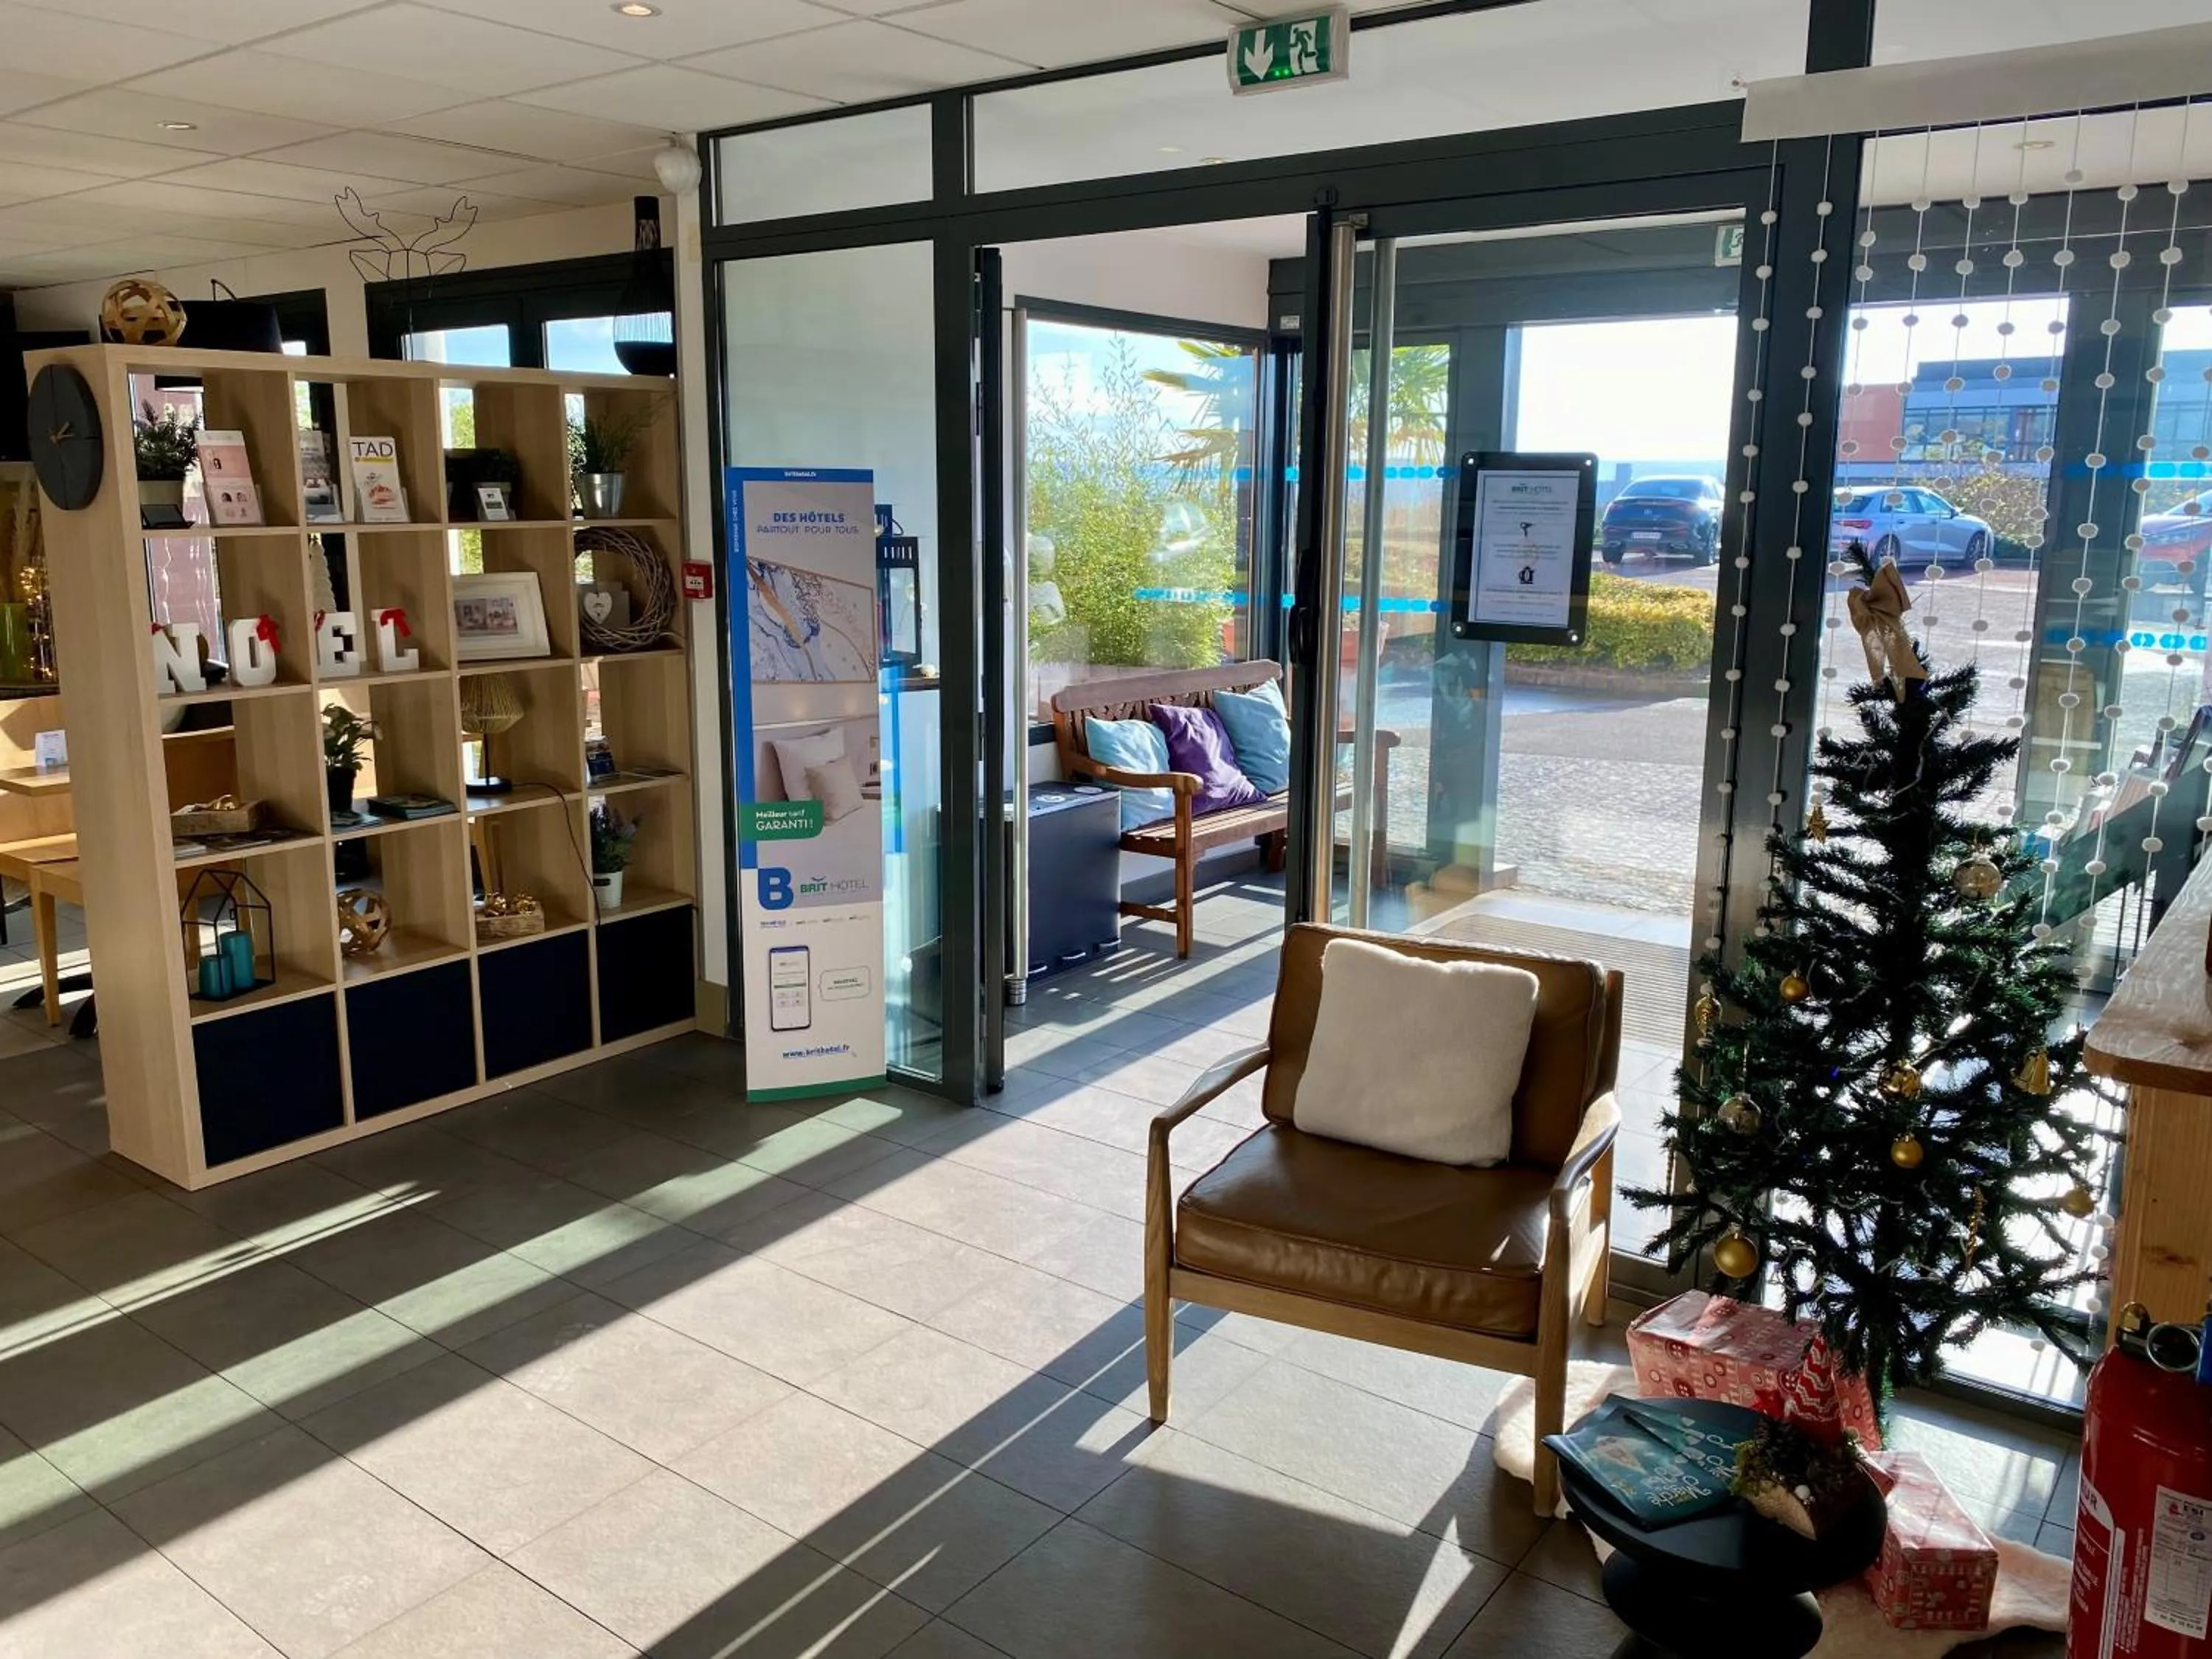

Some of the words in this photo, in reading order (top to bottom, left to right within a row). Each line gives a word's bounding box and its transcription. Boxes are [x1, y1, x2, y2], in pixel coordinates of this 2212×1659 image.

[352, 441, 394, 456] TAD
[773, 512, 797, 523] DES
[799, 511, 845, 523] HÔTELS
[804, 526, 831, 535] POUR
[756, 810, 787, 818] Meilleur
[758, 867, 794, 910] B
[800, 882, 827, 893] BRIT
[830, 878, 869, 891] HOTEL
[782, 1044, 850, 1057] www.brithotel.fr
